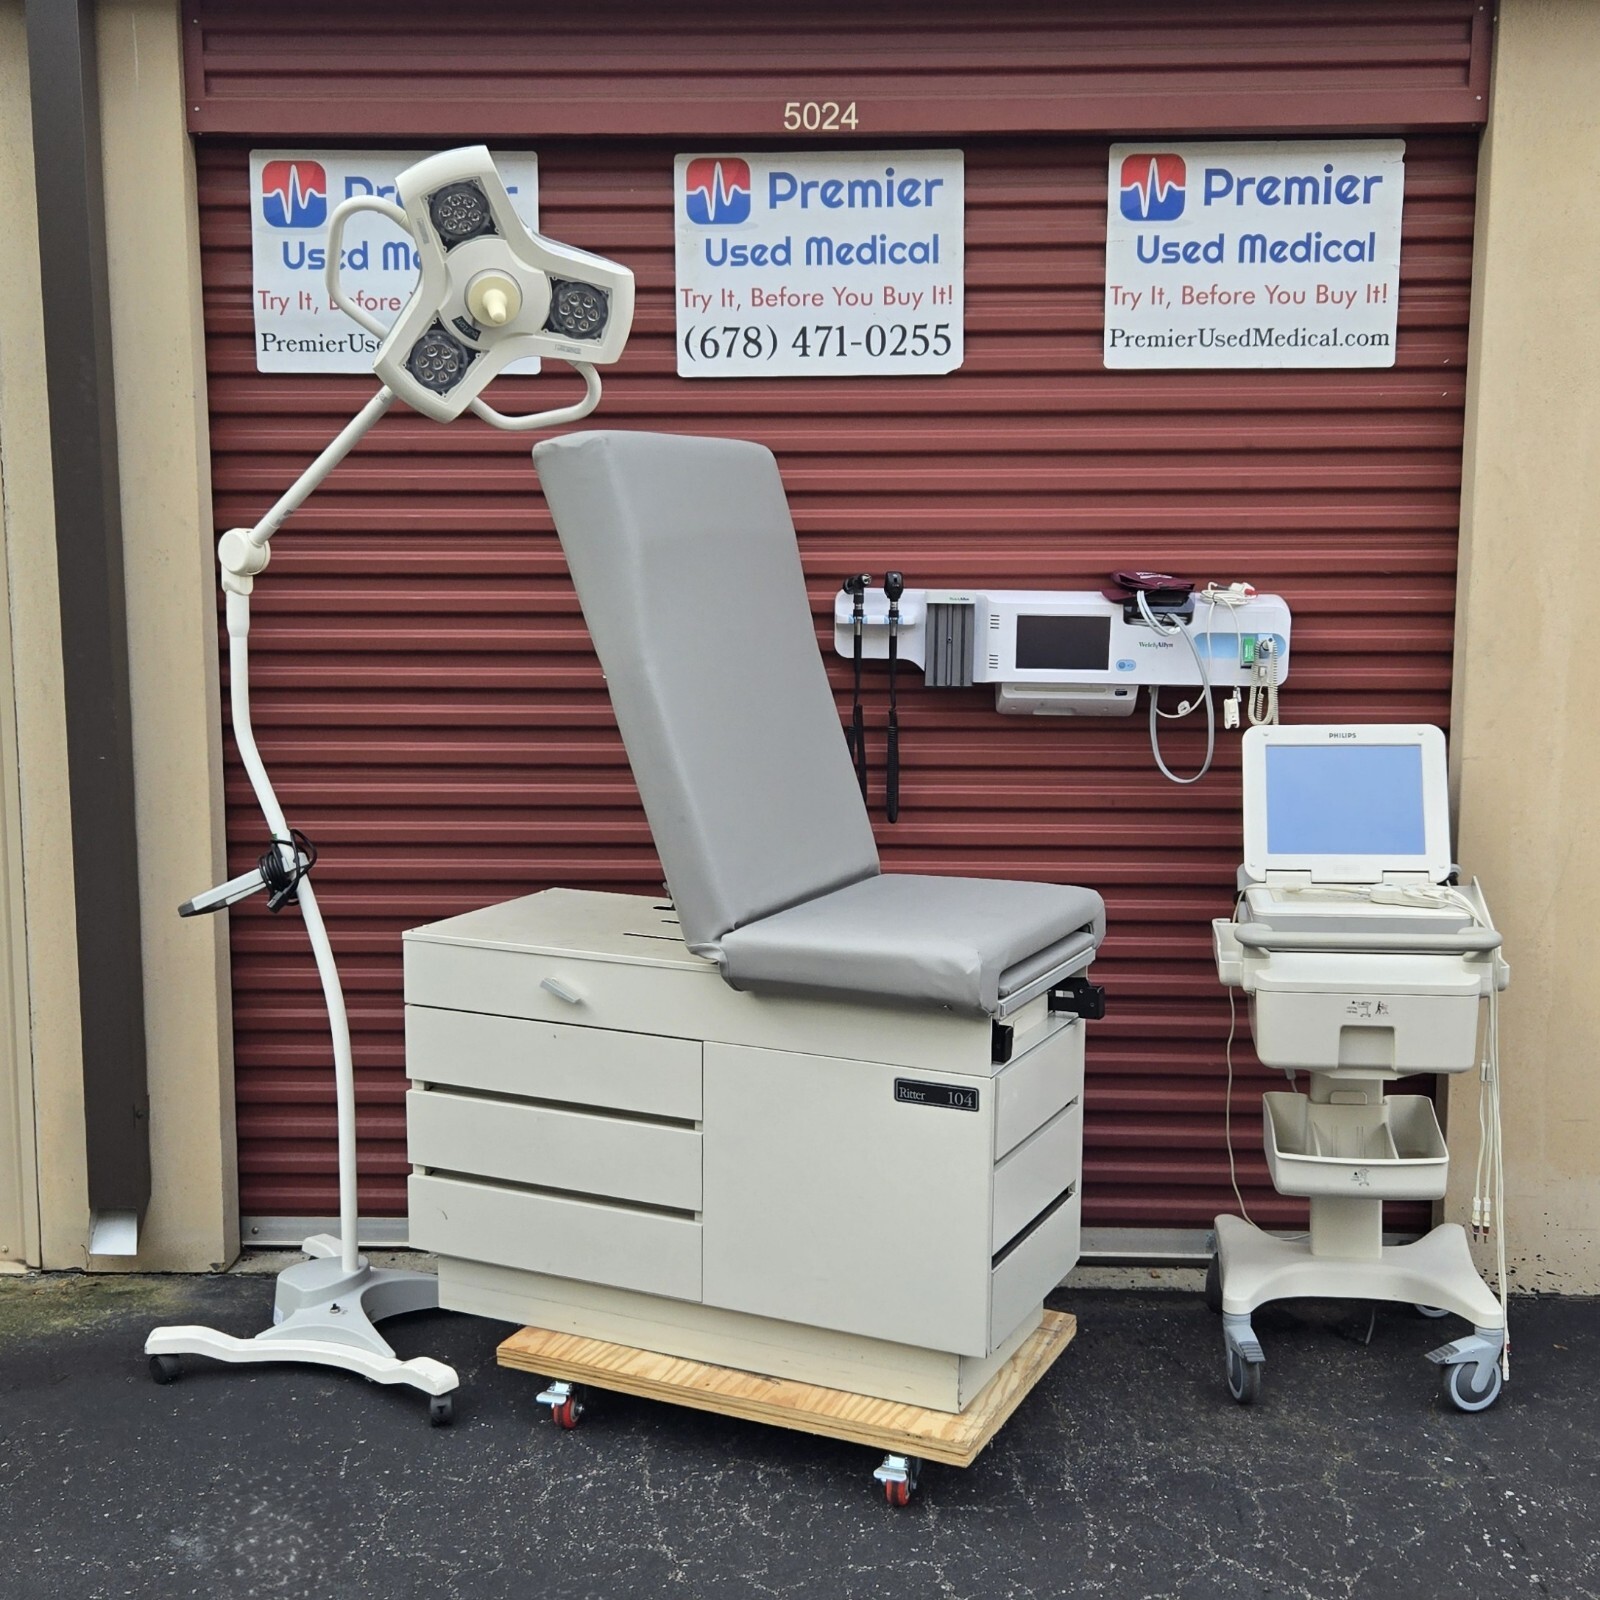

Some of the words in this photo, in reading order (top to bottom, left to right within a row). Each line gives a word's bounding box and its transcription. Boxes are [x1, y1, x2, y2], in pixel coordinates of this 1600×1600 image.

[784, 102, 859, 130] 5024
[768, 167, 944, 209] Premier
[1204, 164, 1383, 206] Premier
[705, 236, 792, 267] Used
[805, 234, 939, 266] Medical
[1137, 233, 1225, 264] Used
[1238, 231, 1375, 263] Medical
[257, 290, 290, 316] Try
[298, 290, 319, 315] It,
[330, 290, 401, 311] fore
[680, 288, 713, 313] Try
[721, 288, 741, 311] It,
[751, 286, 824, 307] Before
[832, 286, 873, 306] You
[883, 285, 924, 310] Buy
[932, 285, 953, 305] It!
[1110, 285, 1142, 310] Try
[1151, 285, 1171, 309] It,
[1182, 284, 1256, 305] Before
[1265, 284, 1306, 304] You
[1316, 284, 1357, 309] Buy
[1366, 283, 1388, 303] It!
[261, 332, 383, 353] PremierUse
[684, 325, 778, 361] (678)
[791, 323, 952, 357] 471-0255
[1109, 327, 1390, 348] PremierUsedMedical.com
[899, 1086, 926, 1101] Ritter
[947, 1091, 973, 1107] 104
